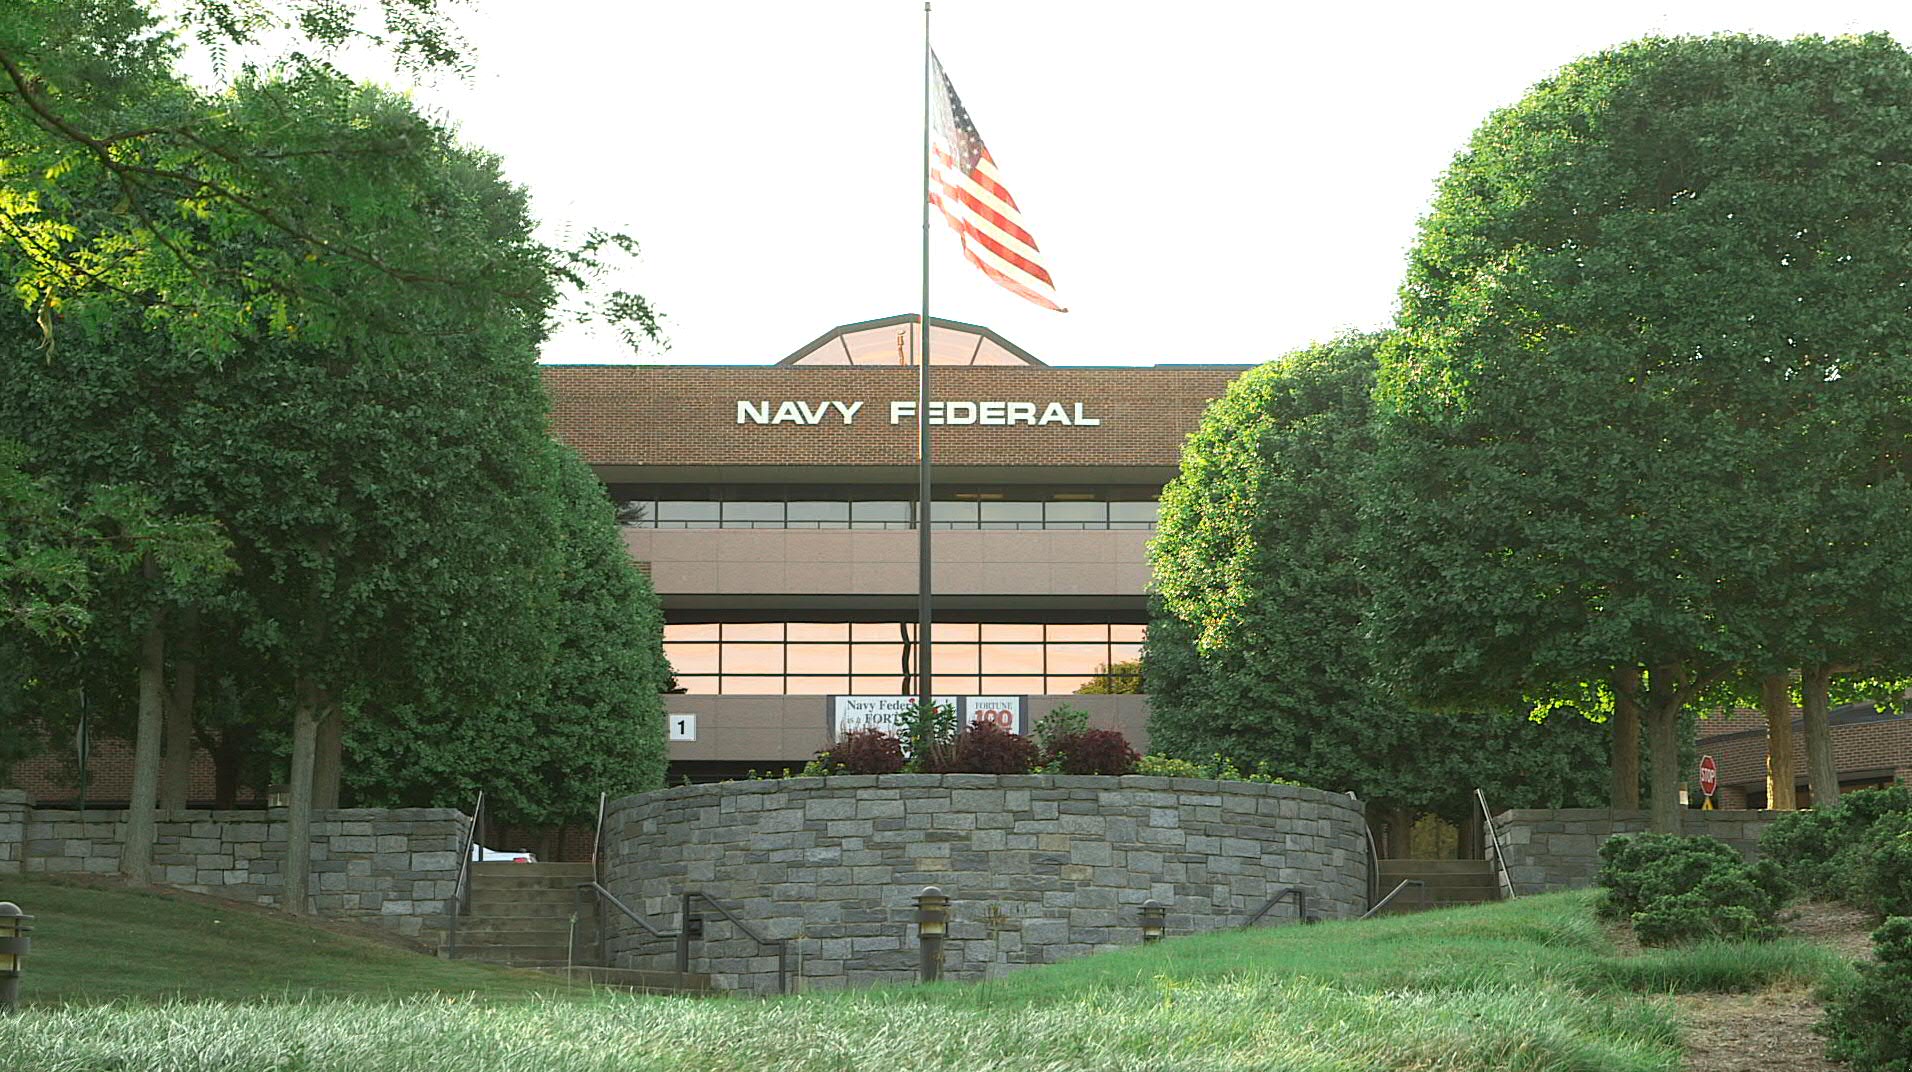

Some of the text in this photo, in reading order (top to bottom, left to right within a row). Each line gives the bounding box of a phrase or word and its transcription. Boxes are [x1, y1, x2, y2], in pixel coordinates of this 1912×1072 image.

[737, 401, 1100, 426] NAVY FEDERAL
[848, 700, 914, 712] Navy Feder
[975, 702, 1013, 710] FORTUNE
[865, 713, 900, 723] FORT
[677, 719, 685, 735] 1
[1701, 767, 1715, 784] STOP
